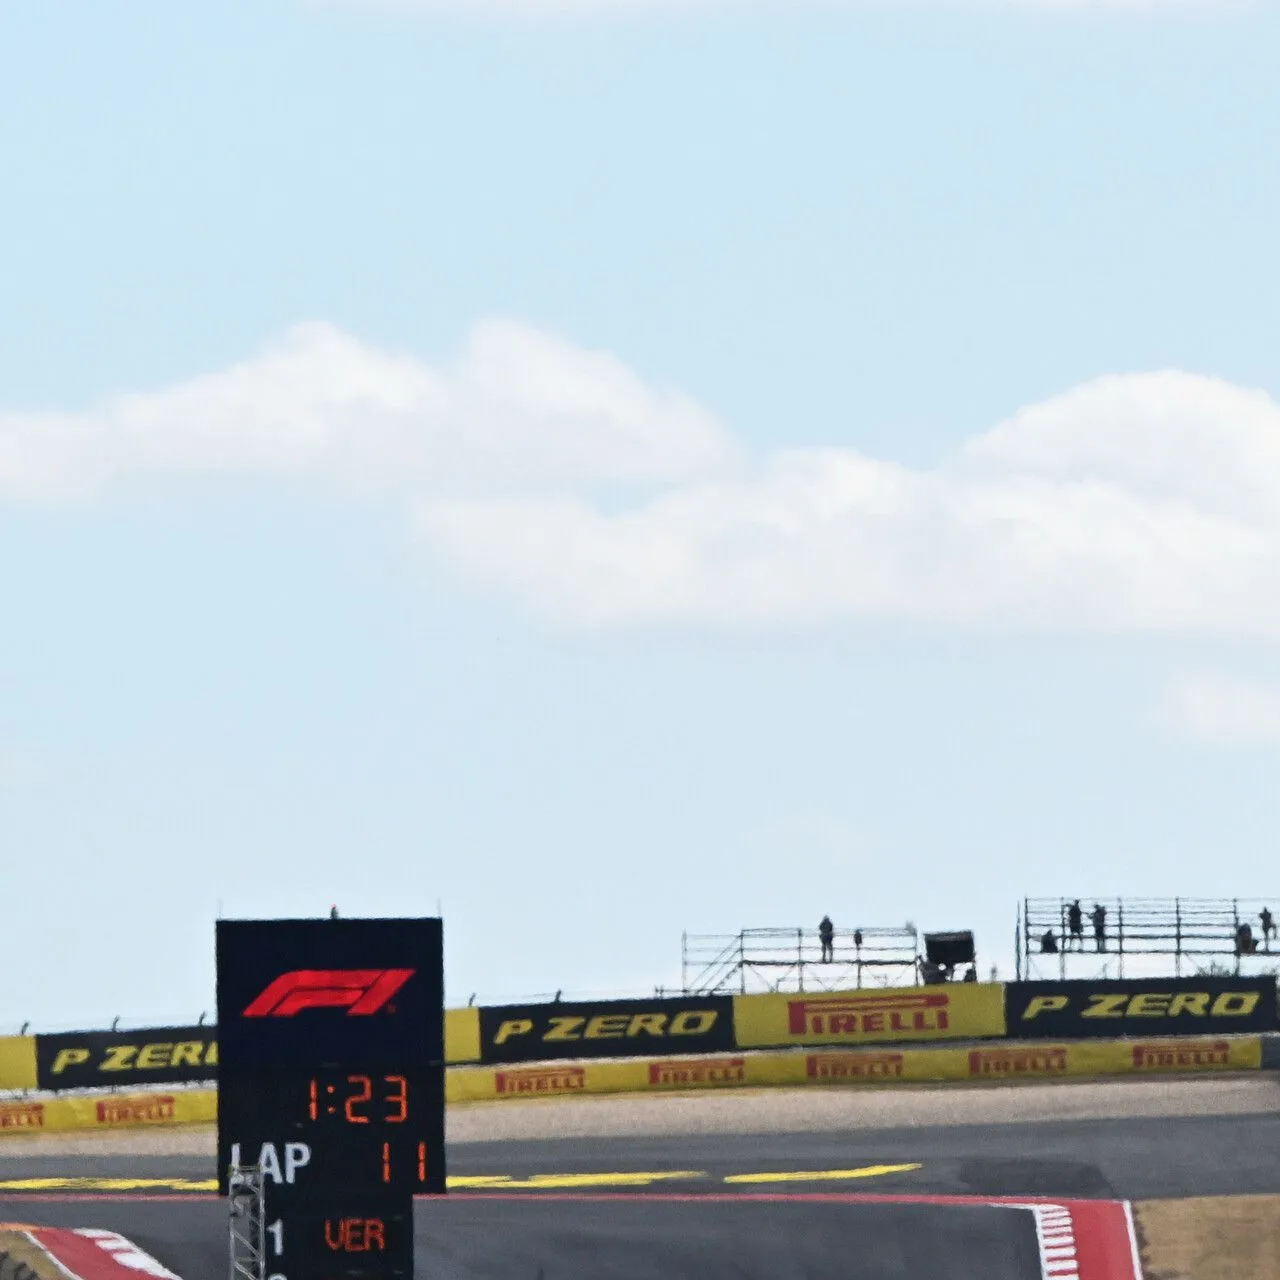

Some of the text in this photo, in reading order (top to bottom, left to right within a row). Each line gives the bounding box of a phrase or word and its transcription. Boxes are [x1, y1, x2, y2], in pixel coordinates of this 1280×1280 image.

[788, 993, 950, 1034] PIRELLI
[1022, 992, 1261, 1020] P ZERO
[494, 1010, 718, 1044] P ZERO
[52, 1048, 90, 1075] P
[309, 1074, 408, 1123] 1:23
[229, 1141, 312, 1184] LAP
[268, 1219, 385, 1254] 1 VER
